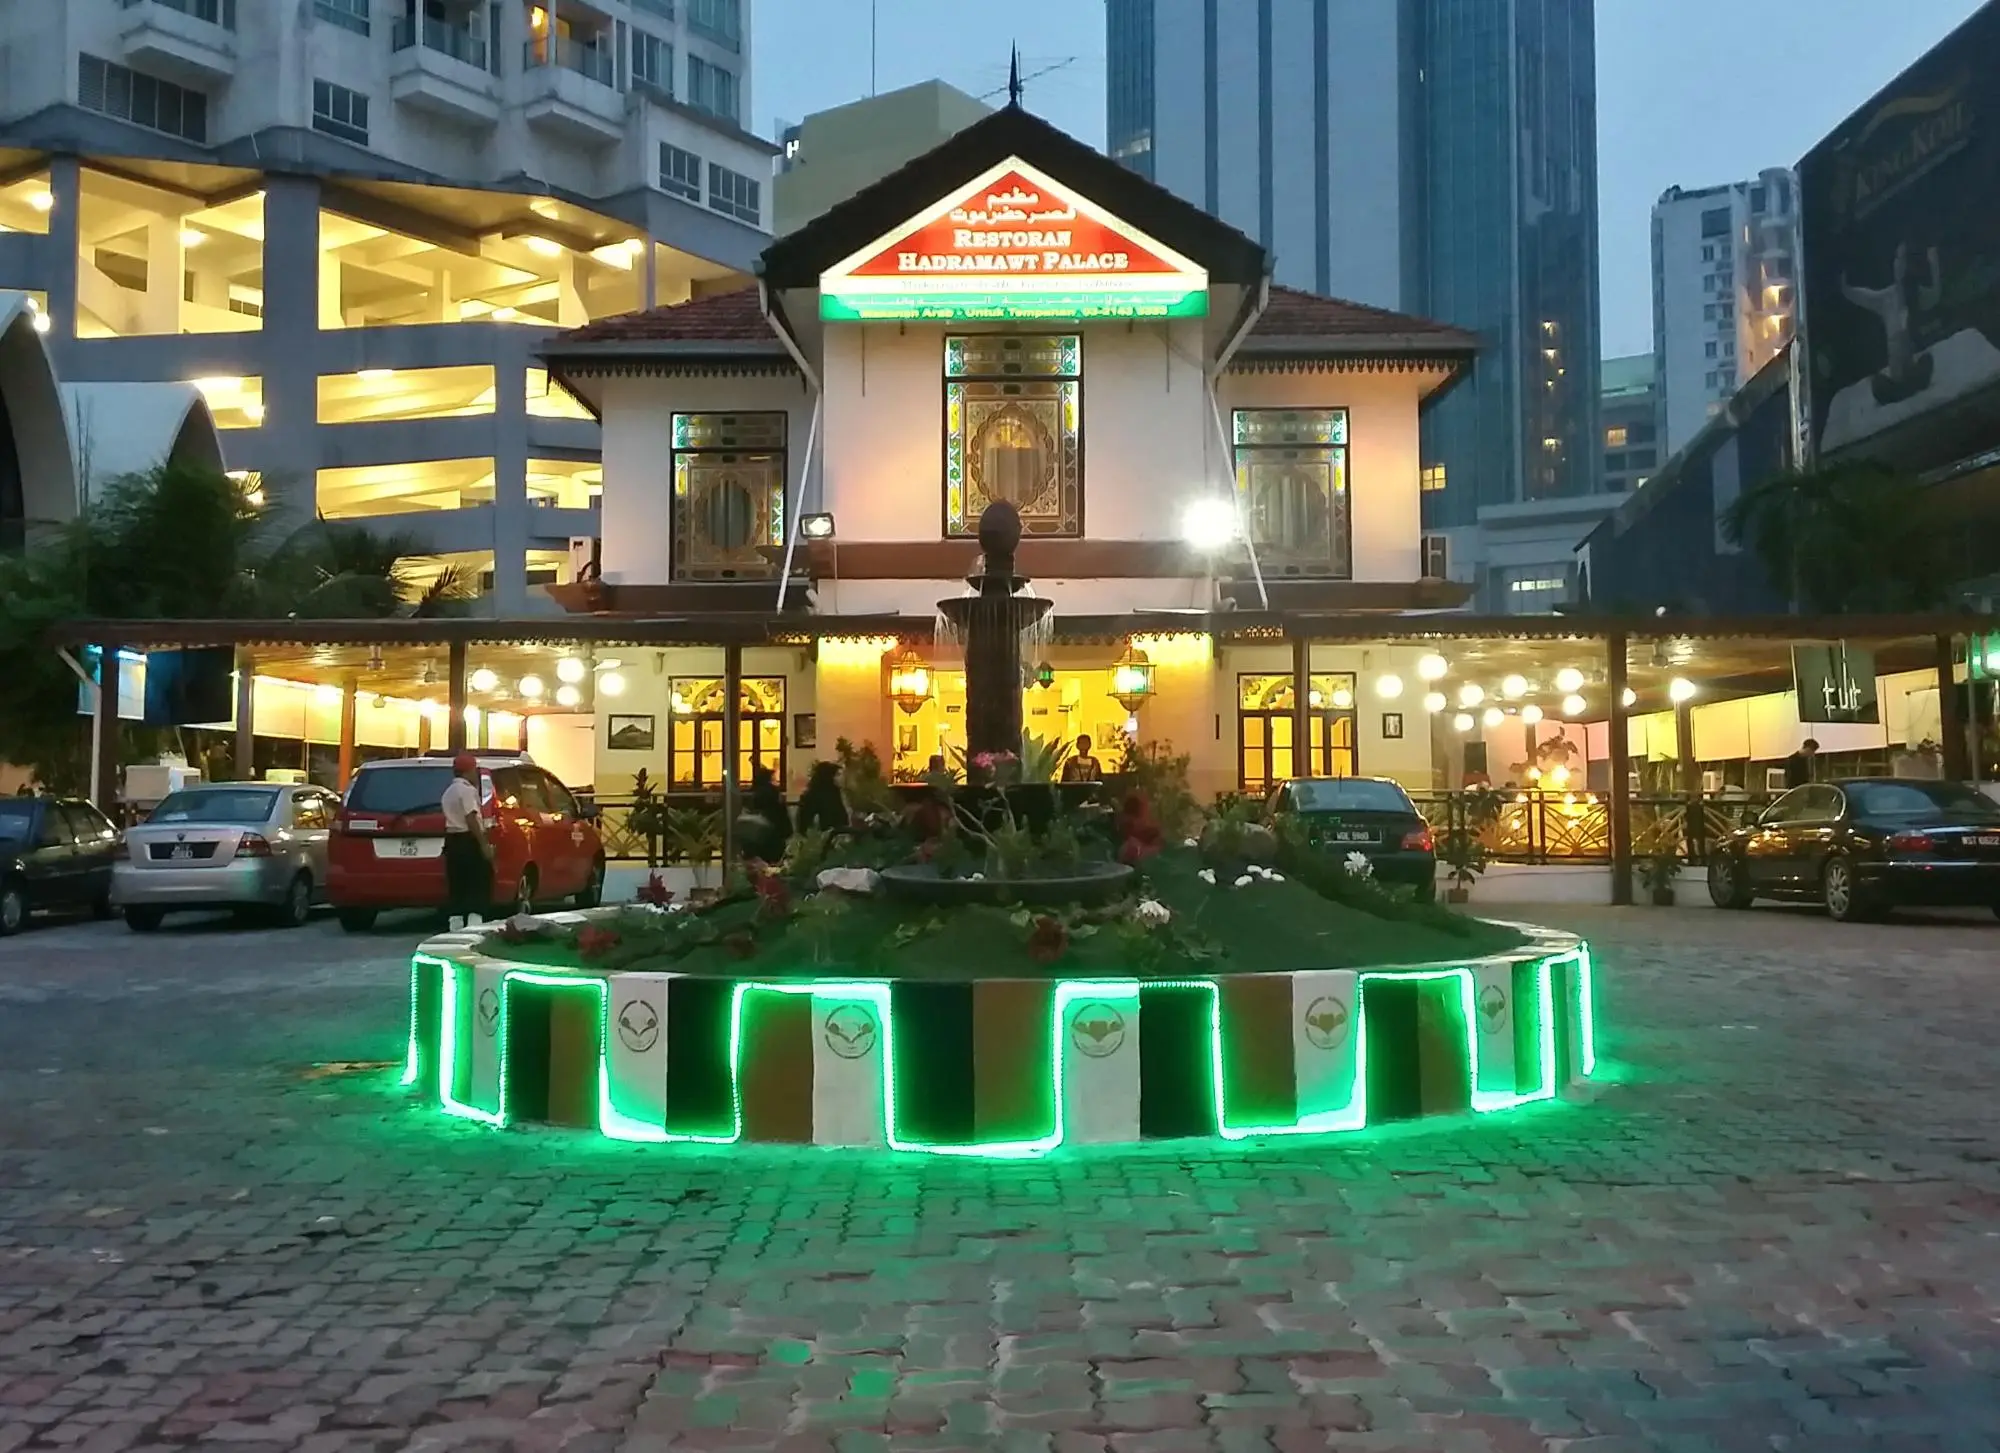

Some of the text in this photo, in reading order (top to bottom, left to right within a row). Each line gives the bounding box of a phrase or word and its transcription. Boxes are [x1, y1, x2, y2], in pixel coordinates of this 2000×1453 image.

[987, 186, 1039, 209] مطعم
[954, 229, 1072, 248] RESTORAN
[898, 251, 1129, 271] HADRAMAWT PALACE
